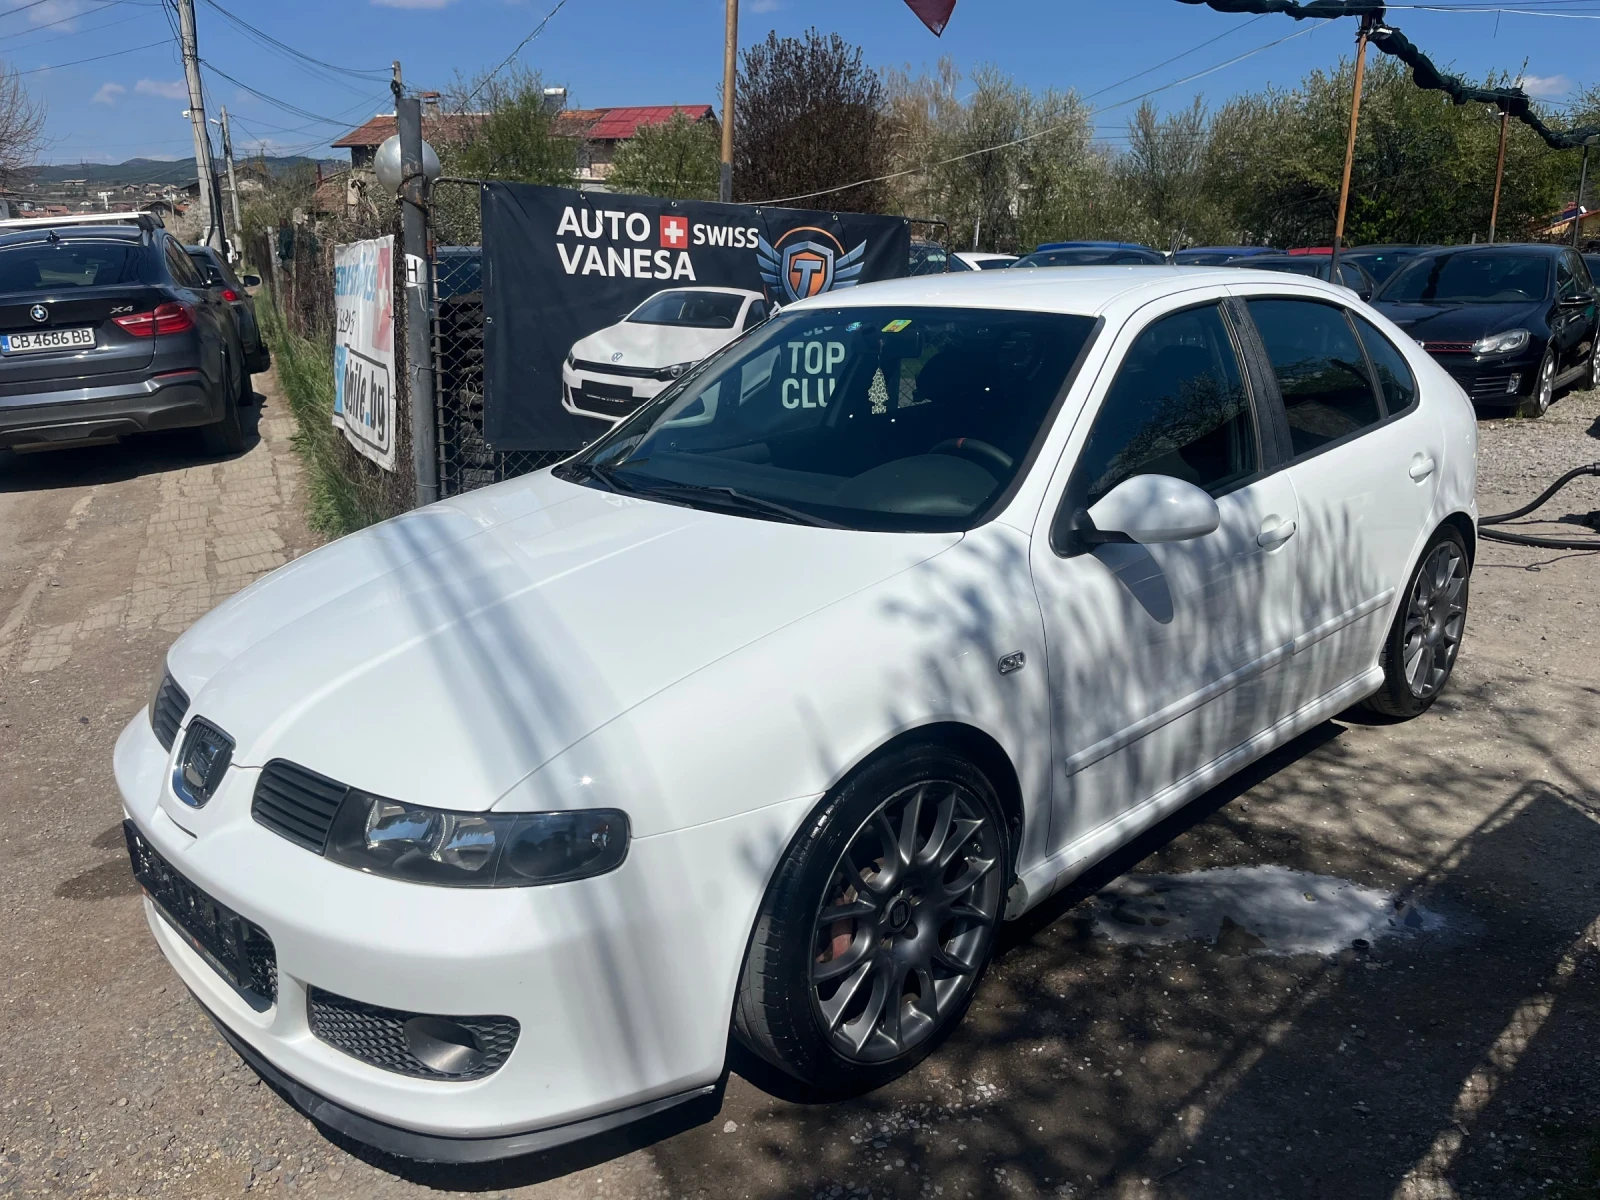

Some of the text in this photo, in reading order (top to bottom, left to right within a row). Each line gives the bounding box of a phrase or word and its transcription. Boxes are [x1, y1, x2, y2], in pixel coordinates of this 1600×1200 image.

[556, 206, 759, 249] AUTO SWISS
[556, 243, 697, 281] VANESA
[10, 329, 92, 349] CB 4686 BB
[787, 341, 845, 375] TOP
[781, 377, 836, 410] CLU
